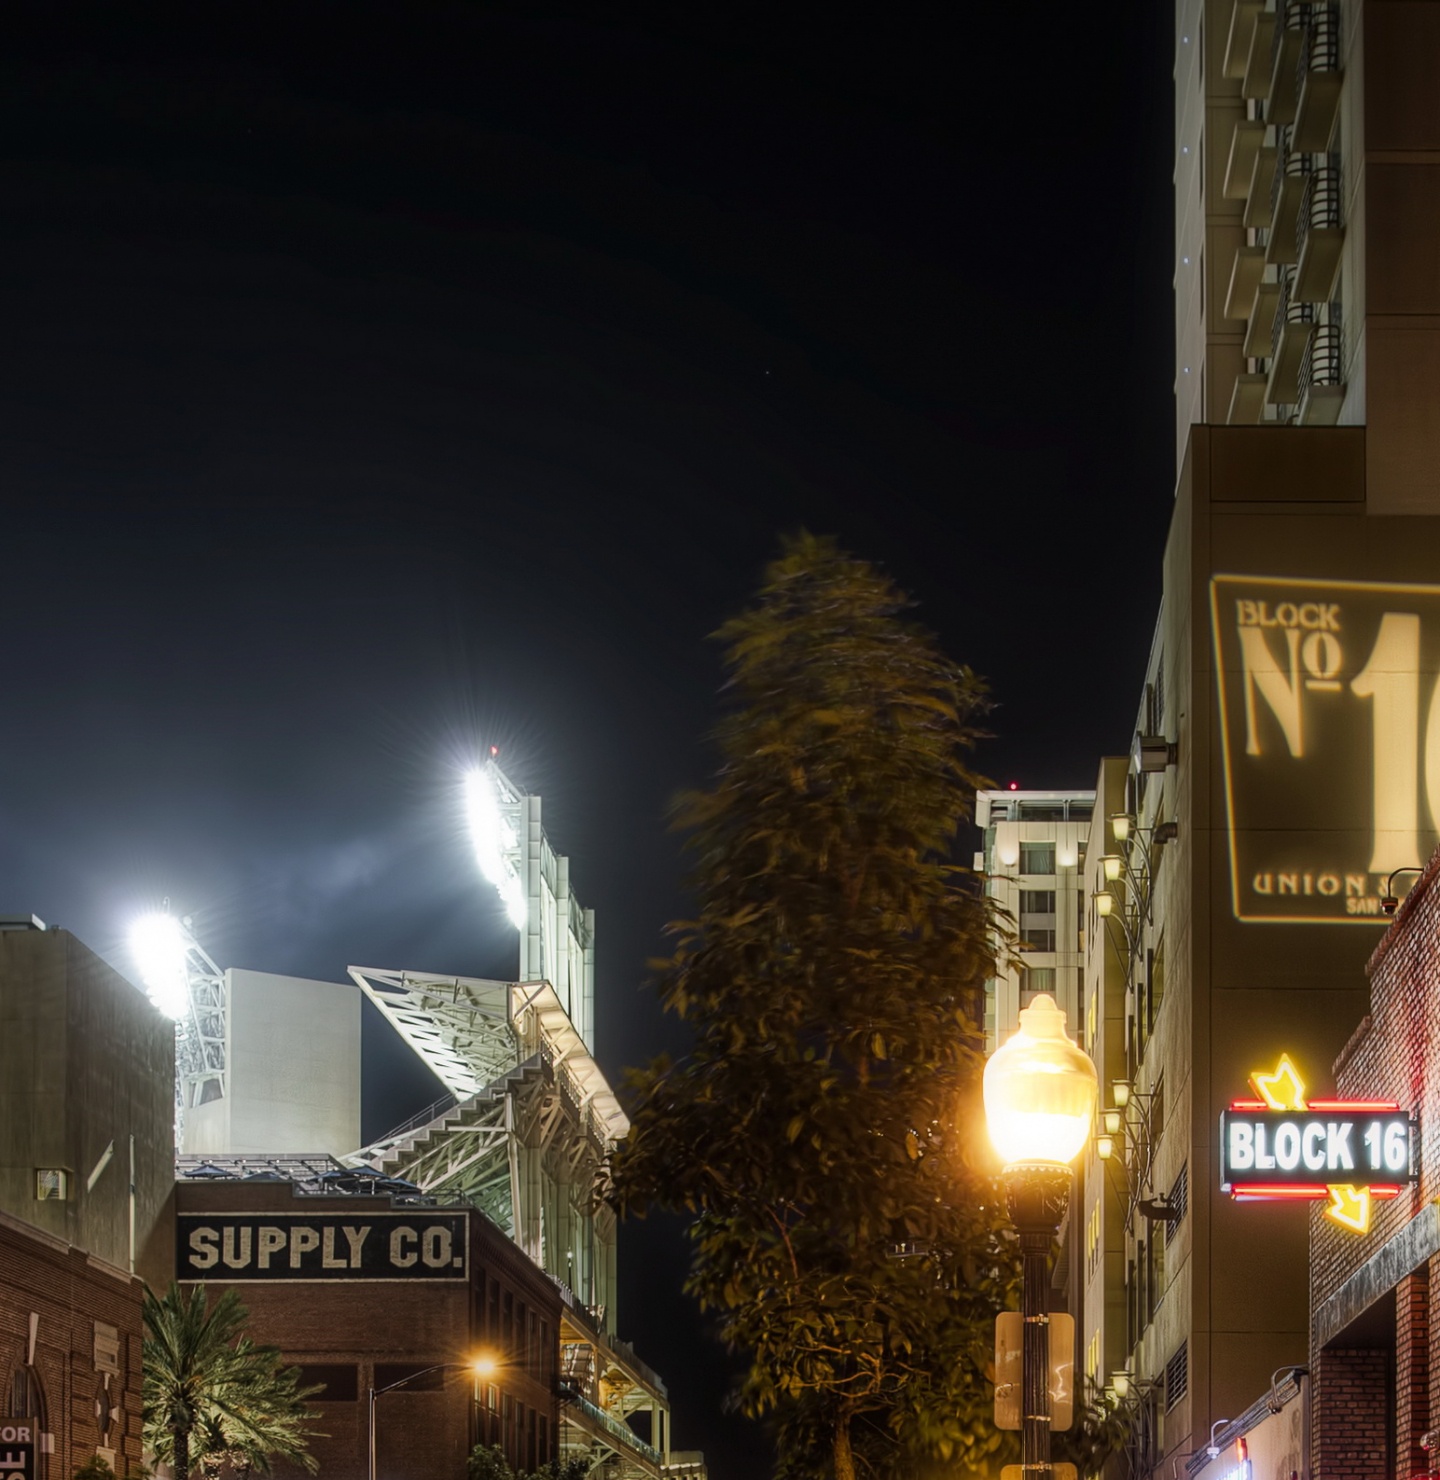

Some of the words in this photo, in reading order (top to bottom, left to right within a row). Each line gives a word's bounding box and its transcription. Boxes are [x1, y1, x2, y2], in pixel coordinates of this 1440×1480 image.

[1236, 599, 1342, 631] BLOCK
[1253, 872, 1367, 896] UNION
[1346, 897, 1378, 915] SAN
[1229, 1122, 1355, 1170] BLOCK
[1364, 1122, 1406, 1170] 16
[188, 1226, 372, 1269] SUPPLY
[390, 1226, 462, 1268] CO.
